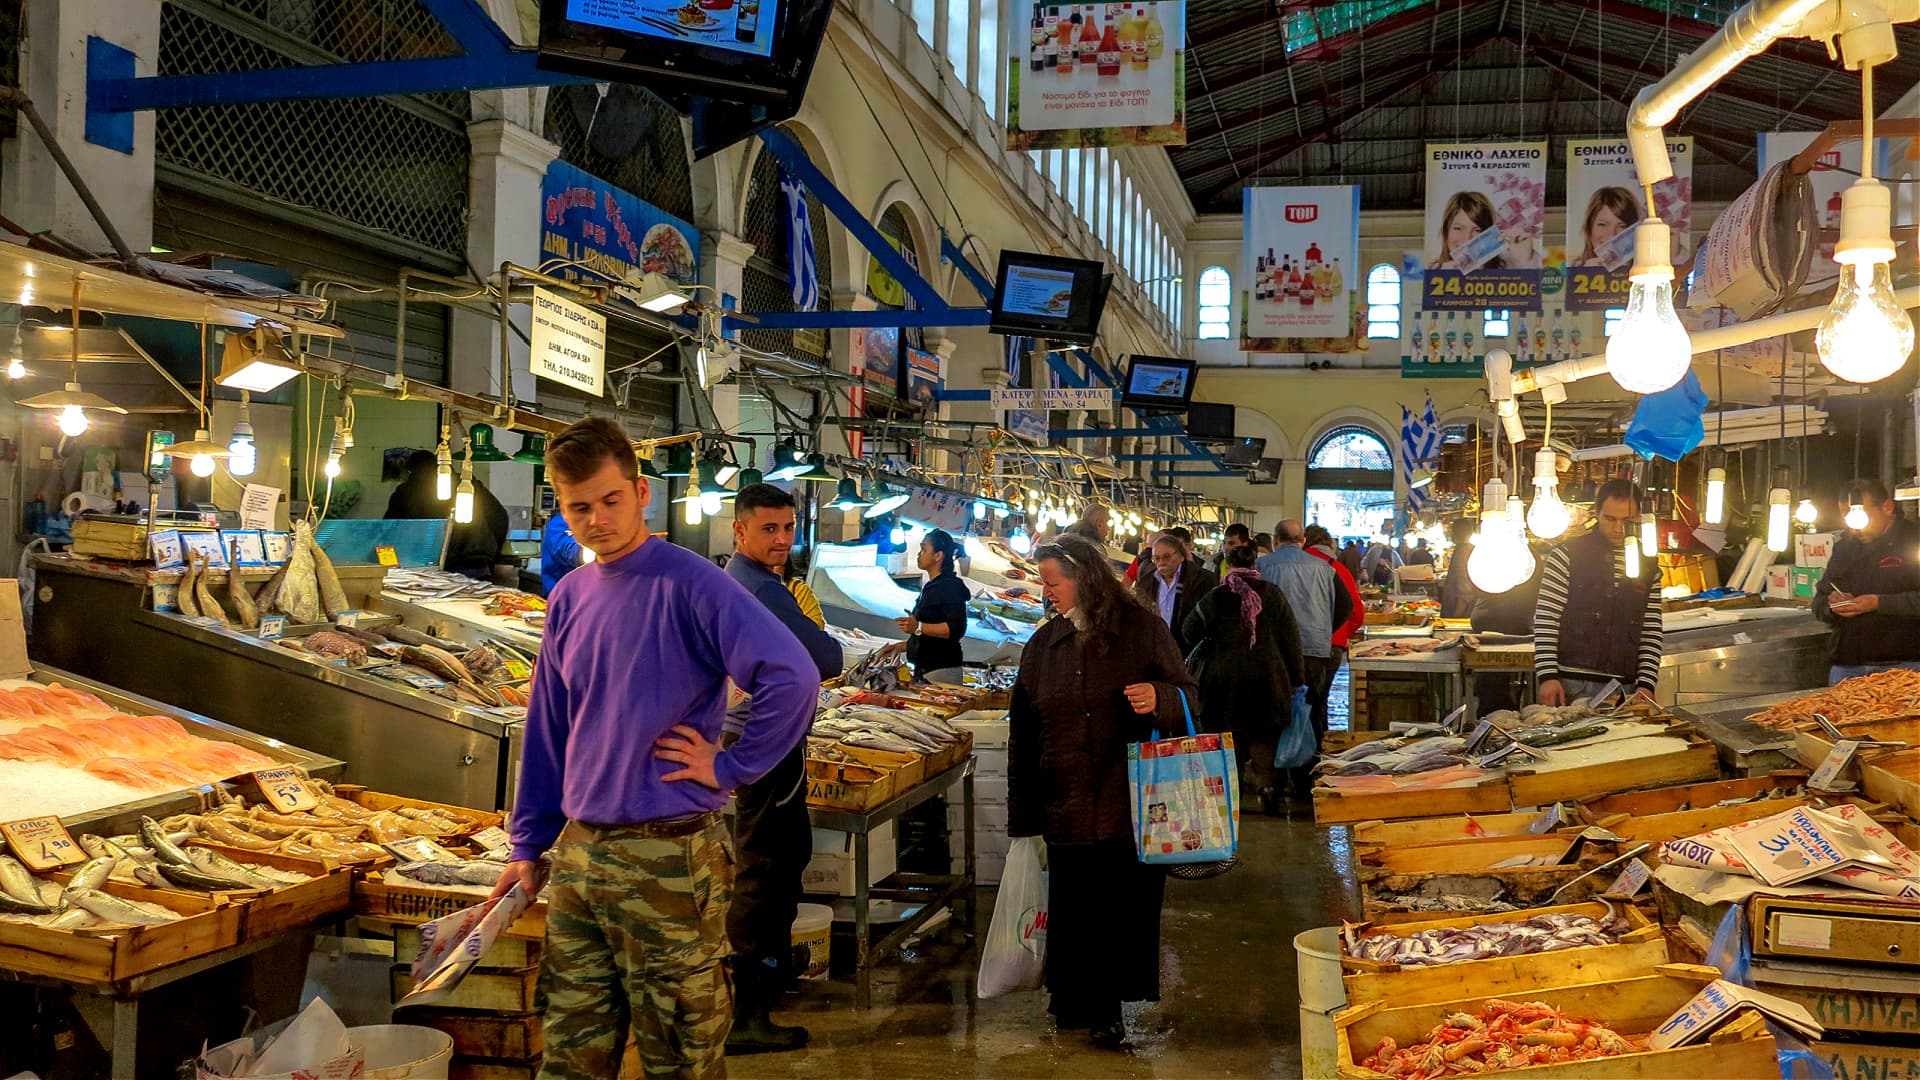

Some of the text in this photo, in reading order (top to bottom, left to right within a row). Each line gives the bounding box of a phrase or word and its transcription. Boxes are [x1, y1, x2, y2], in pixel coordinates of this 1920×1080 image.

[1432, 148, 1541, 161] ΕΘΝΙΚΟ ΛΑΧΕΙΟ
[1574, 145, 1628, 157] ΕΘΝΙΚΟ
[1442, 161, 1448, 170] 3
[1472, 161, 1479, 169] 4
[1584, 157, 1590, 166] 3
[1615, 157, 1622, 165] 4
[1288, 207, 1315, 220] ΤΟΠ
[1429, 275, 1537, 297] 24.000.000€
[543, 359, 559, 373] ΤΗΛ.
[1075, 390, 1103, 400] ΨΑΡΙΑ
[1077, 400, 1086, 409] 54
